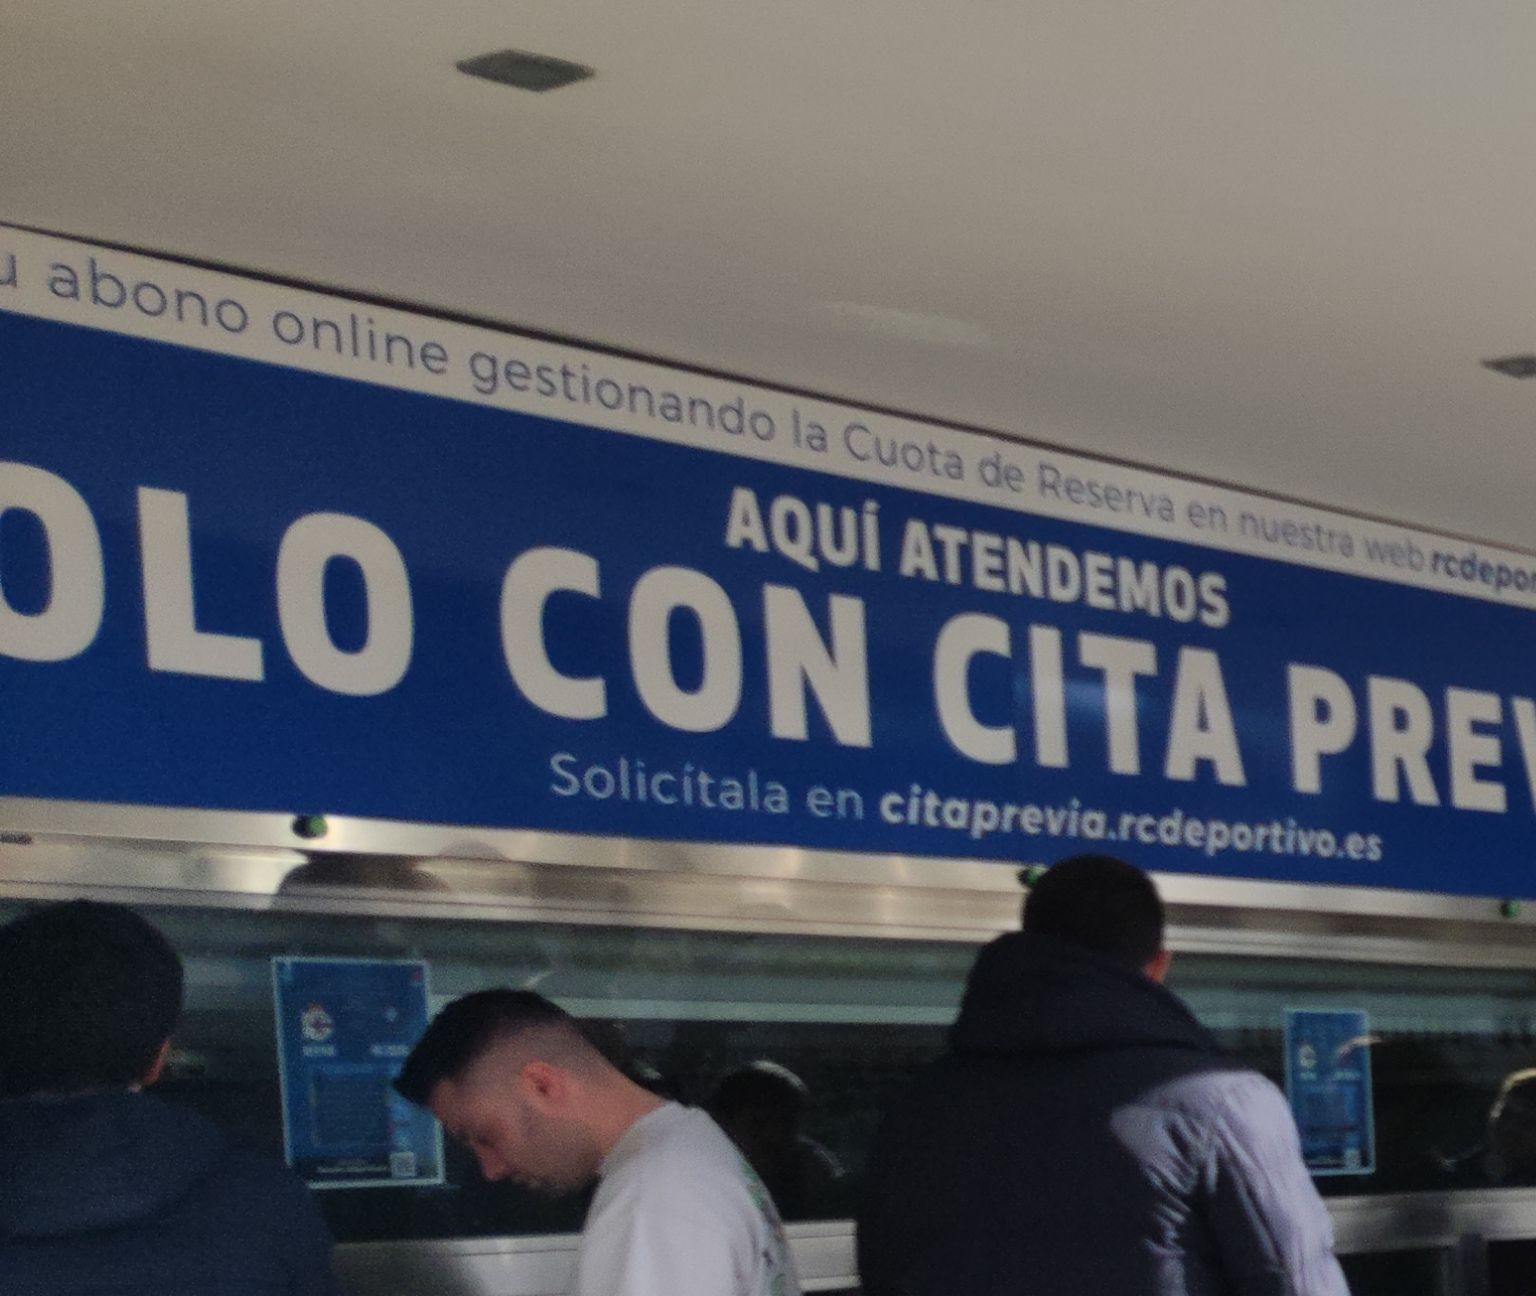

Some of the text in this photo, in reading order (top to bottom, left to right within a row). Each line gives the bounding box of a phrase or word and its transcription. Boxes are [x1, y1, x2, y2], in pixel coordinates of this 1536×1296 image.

[48, 257, 249, 333] abono
[272, 312, 449, 375] online
[468, 350, 776, 442] gestionando
[791, 408, 828, 453] la
[843, 423, 965, 482] Cuota
[978, 452, 1025, 492] de
[1037, 462, 1176, 523] Reserva
[1188, 502, 1227, 534] en
[1239, 511, 1354, 558] nuestra
[1365, 536, 1424, 572] web
[725, 485, 1231, 629] AQUÍ ATENDEMOS
[499, 546, 873, 749] CON
[932, 612, 1246, 787] CITA
[549, 751, 1384, 862] Solicítala en citaprevia.rcdeportivo.es
